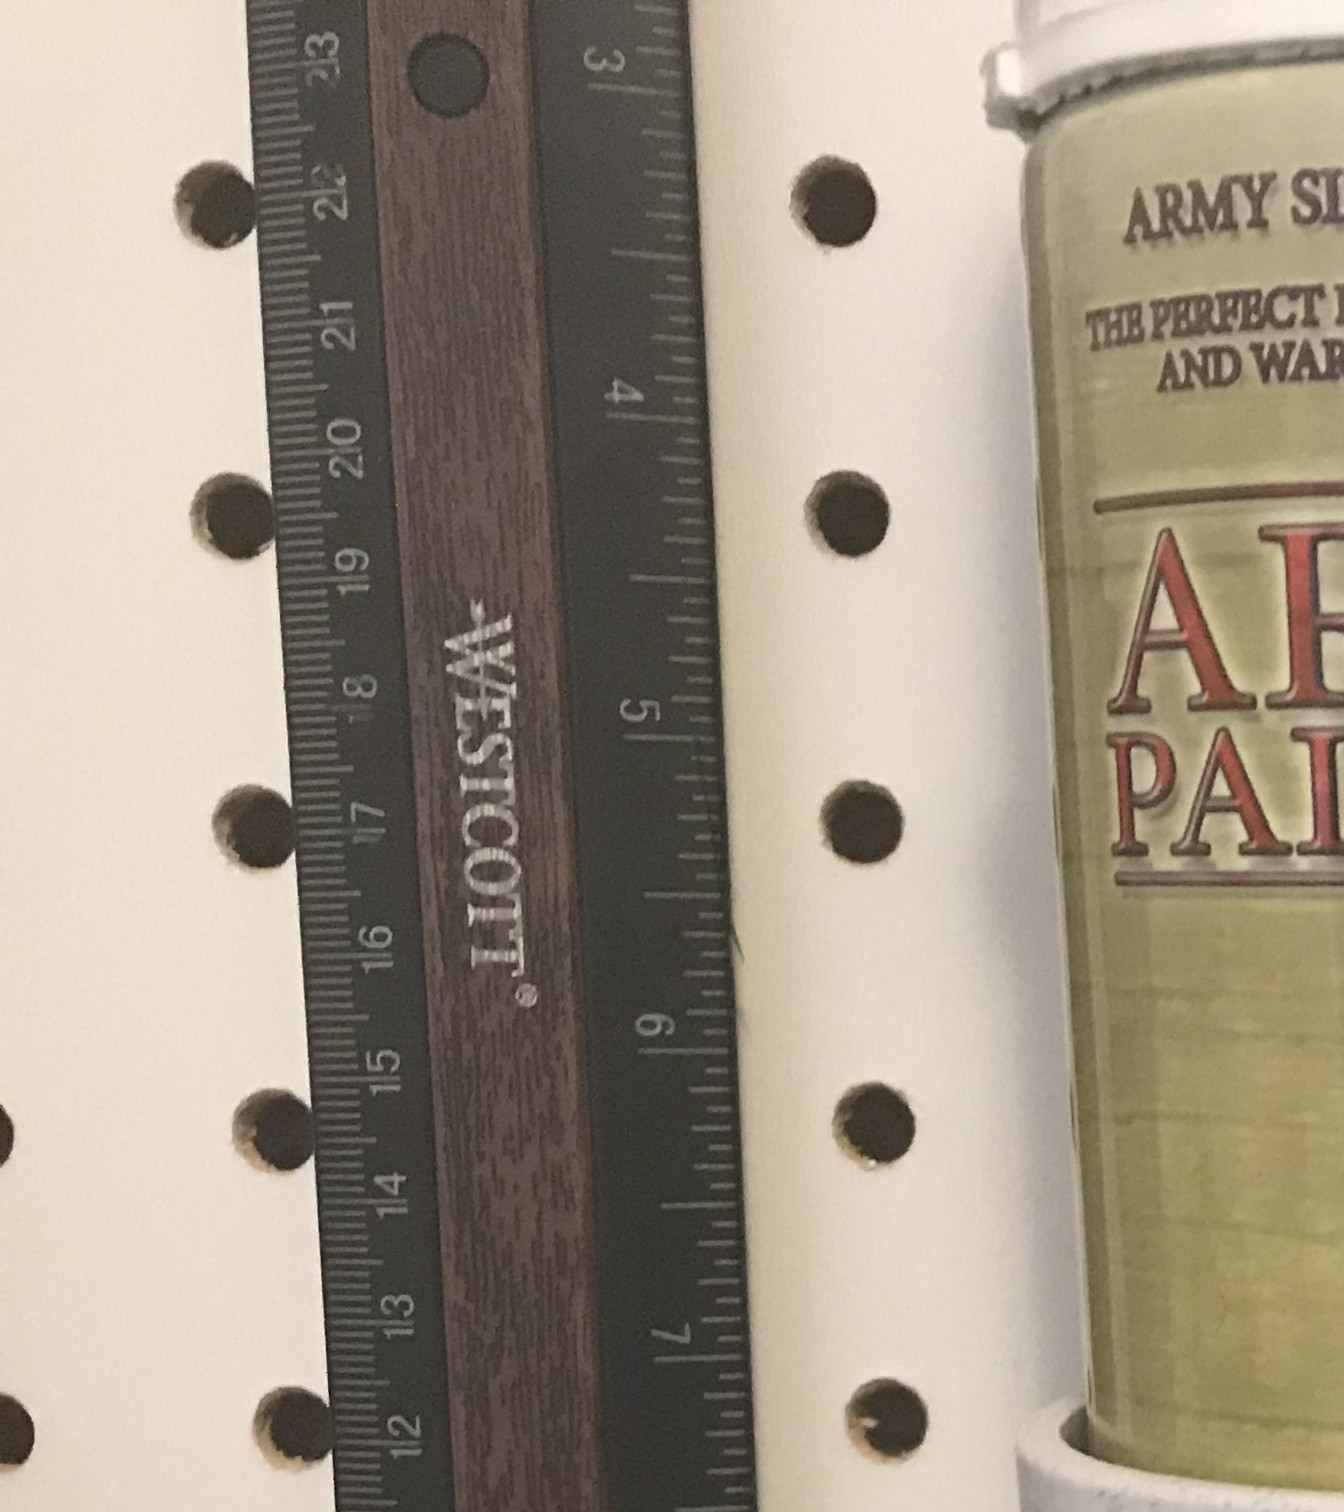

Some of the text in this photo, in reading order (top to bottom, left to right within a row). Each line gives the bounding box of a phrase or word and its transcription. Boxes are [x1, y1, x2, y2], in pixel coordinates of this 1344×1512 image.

[583, 46, 627, 74] 3
[1123, 172, 1276, 246] ARMY
[320, 301, 357, 352] 21
[1086, 307, 1146, 351] THE
[1150, 286, 1325, 342] PERFECT
[604, 377, 645, 405] 4
[1157, 341, 1243, 394] AND
[325, 417, 365, 481] 20
[334, 547, 372, 598] 19
[620, 698, 661, 724] 5
[358, 923, 395, 974] 16
[364, 1049, 401, 1098] 15
[373, 1171, 409, 1220] 14
[380, 1293, 416, 1341] 13
[650, 1322, 692, 1345] 7
[387, 1414, 424, 1460] 12
